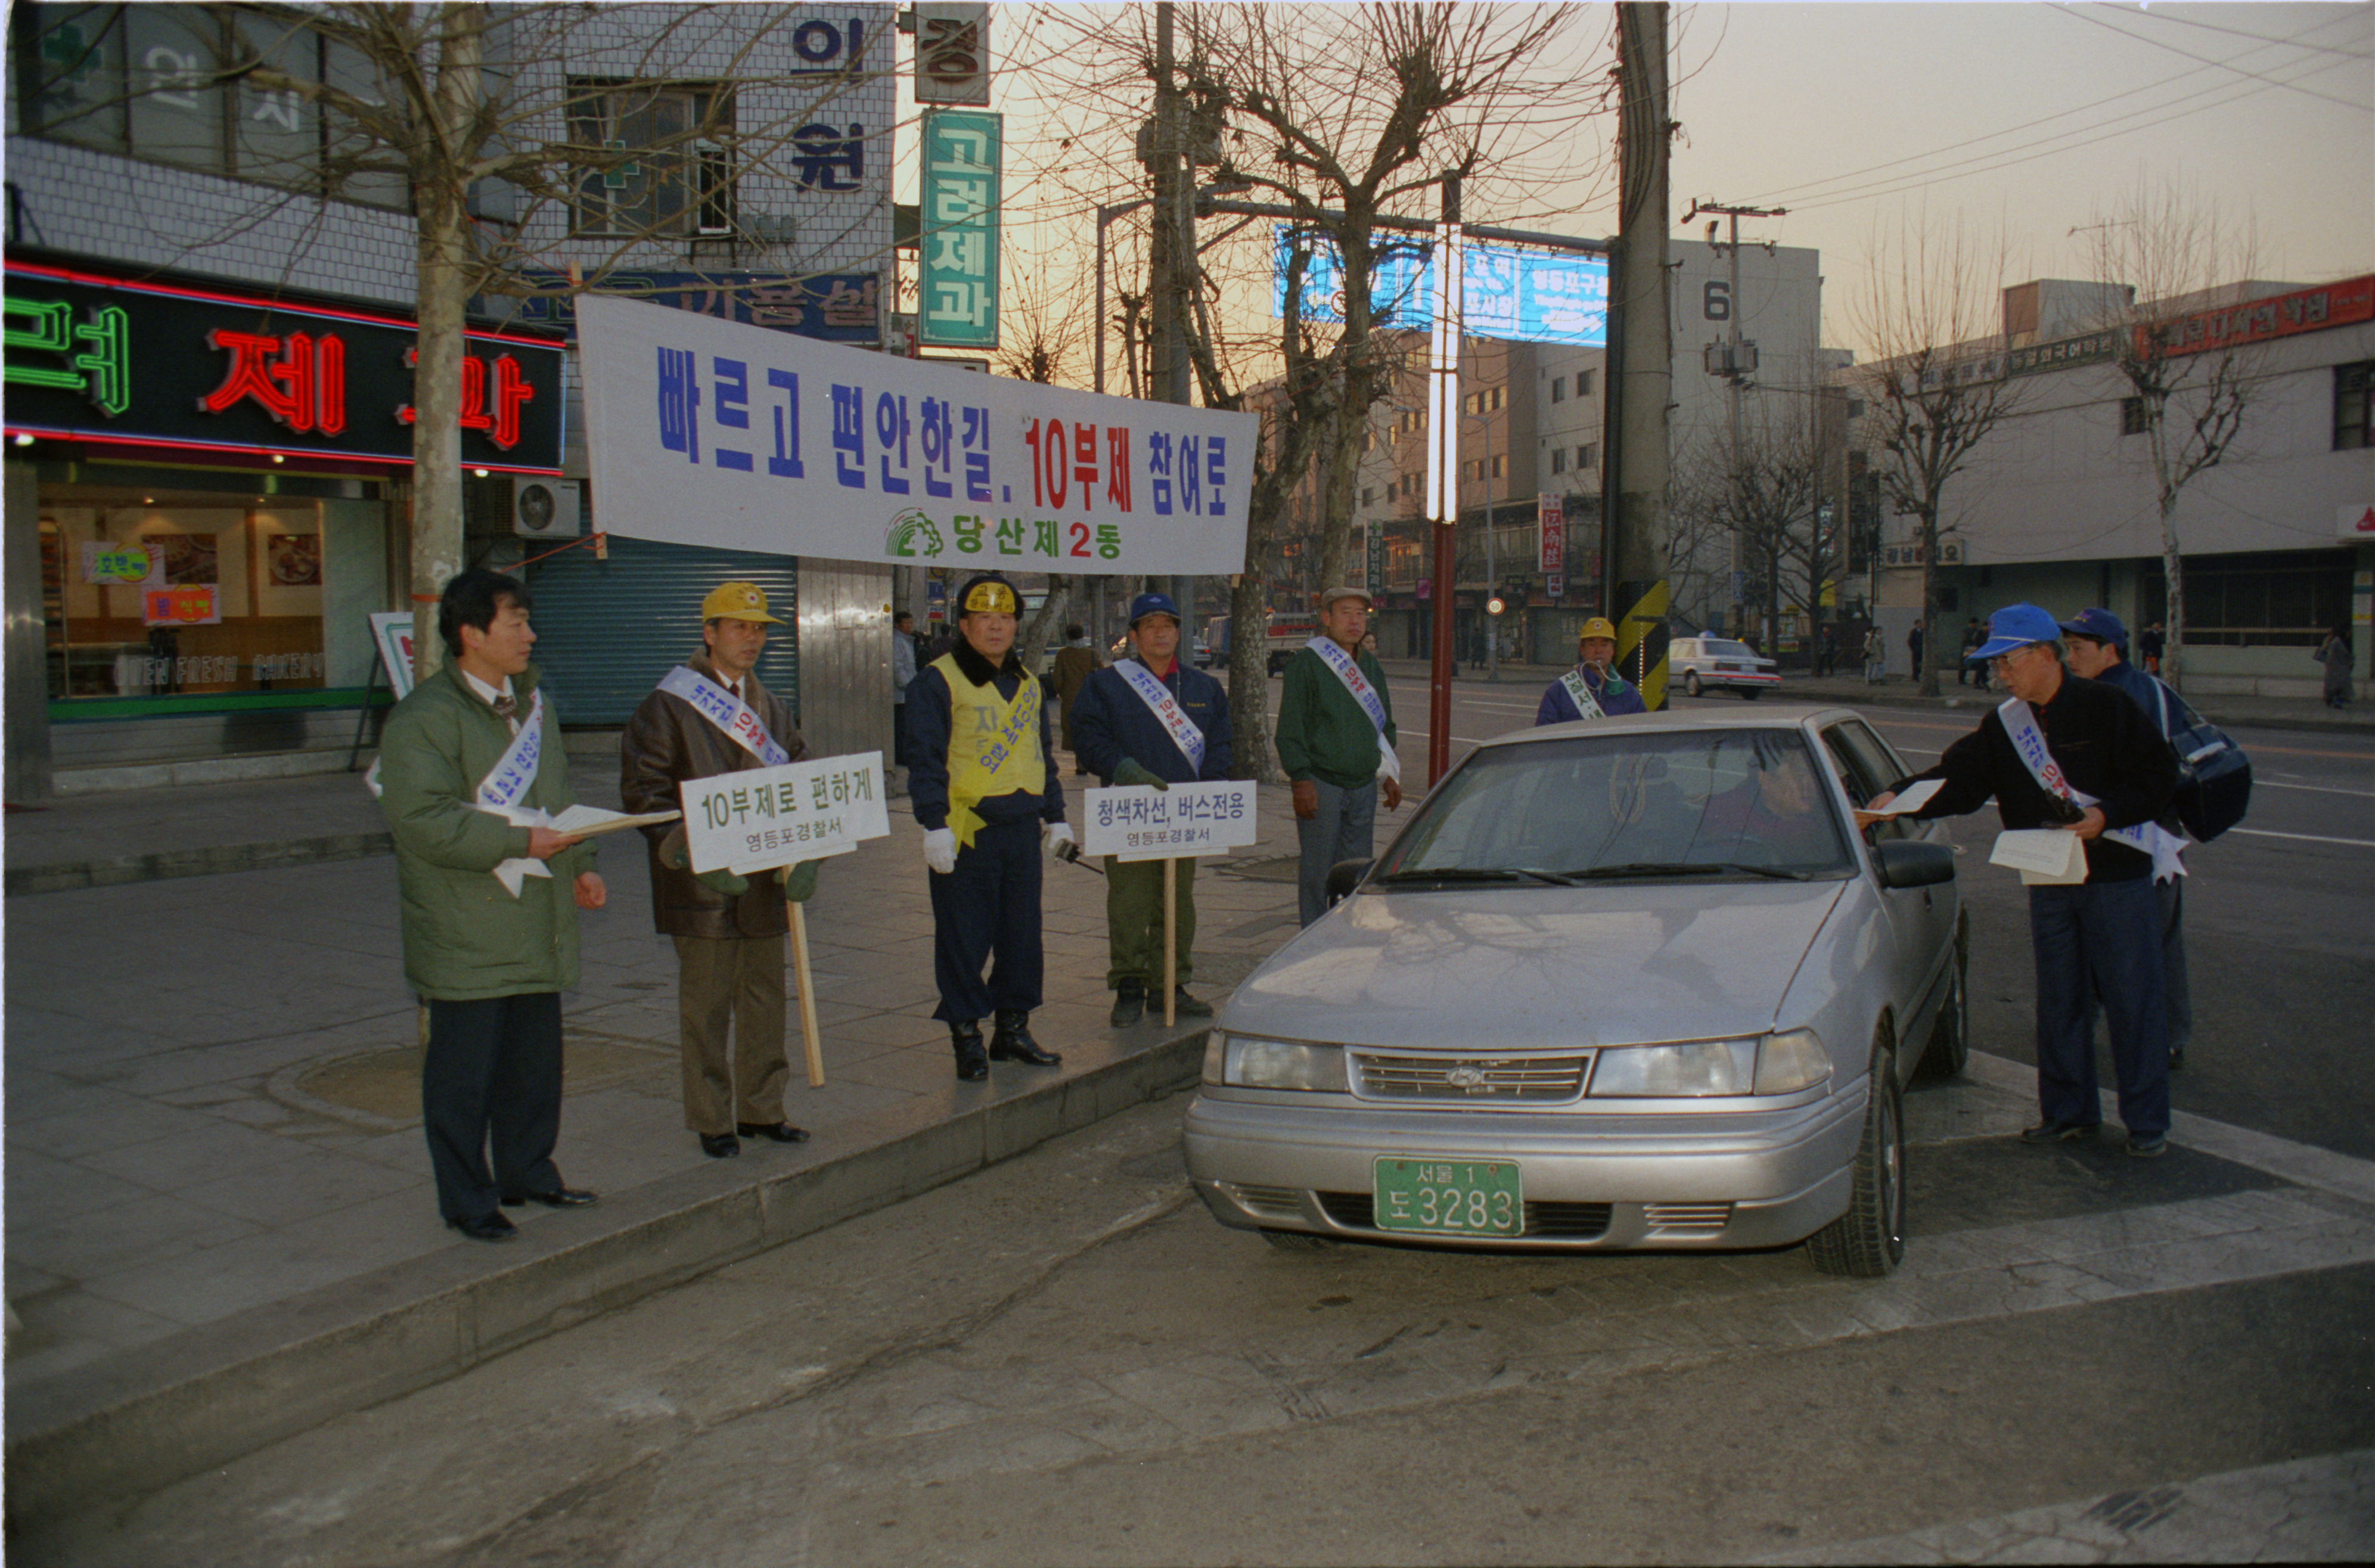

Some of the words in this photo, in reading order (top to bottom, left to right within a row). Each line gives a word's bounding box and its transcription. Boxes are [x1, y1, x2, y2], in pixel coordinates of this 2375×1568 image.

[928, 127, 994, 327] 고려제과
[679, 278, 876, 327] 미용실
[1704, 281, 1730, 321] 6
[657, 346, 805, 479] 빠르고
[1025, 417, 1132, 513] 10부제
[1149, 430, 1227, 516] 참여로
[954, 514, 1122, 560] 당산제2동
[175, 654, 238, 684] FRESH
[252, 651, 326, 682] BAKERY
[701, 782, 797, 830] 10부제로
[811, 766, 873, 811] 편하게
[1178, 792, 1245, 822] 버스전용
[746, 816, 843, 853] 영등포경찰서
[1126, 827, 1210, 847] 영등포경찰서
[1416, 1164, 1453, 1184] 서울
[1466, 1166, 1474, 1185] 1
[1389, 1190, 1412, 1219] 도
[1418, 1187, 1514, 1231] 3283
